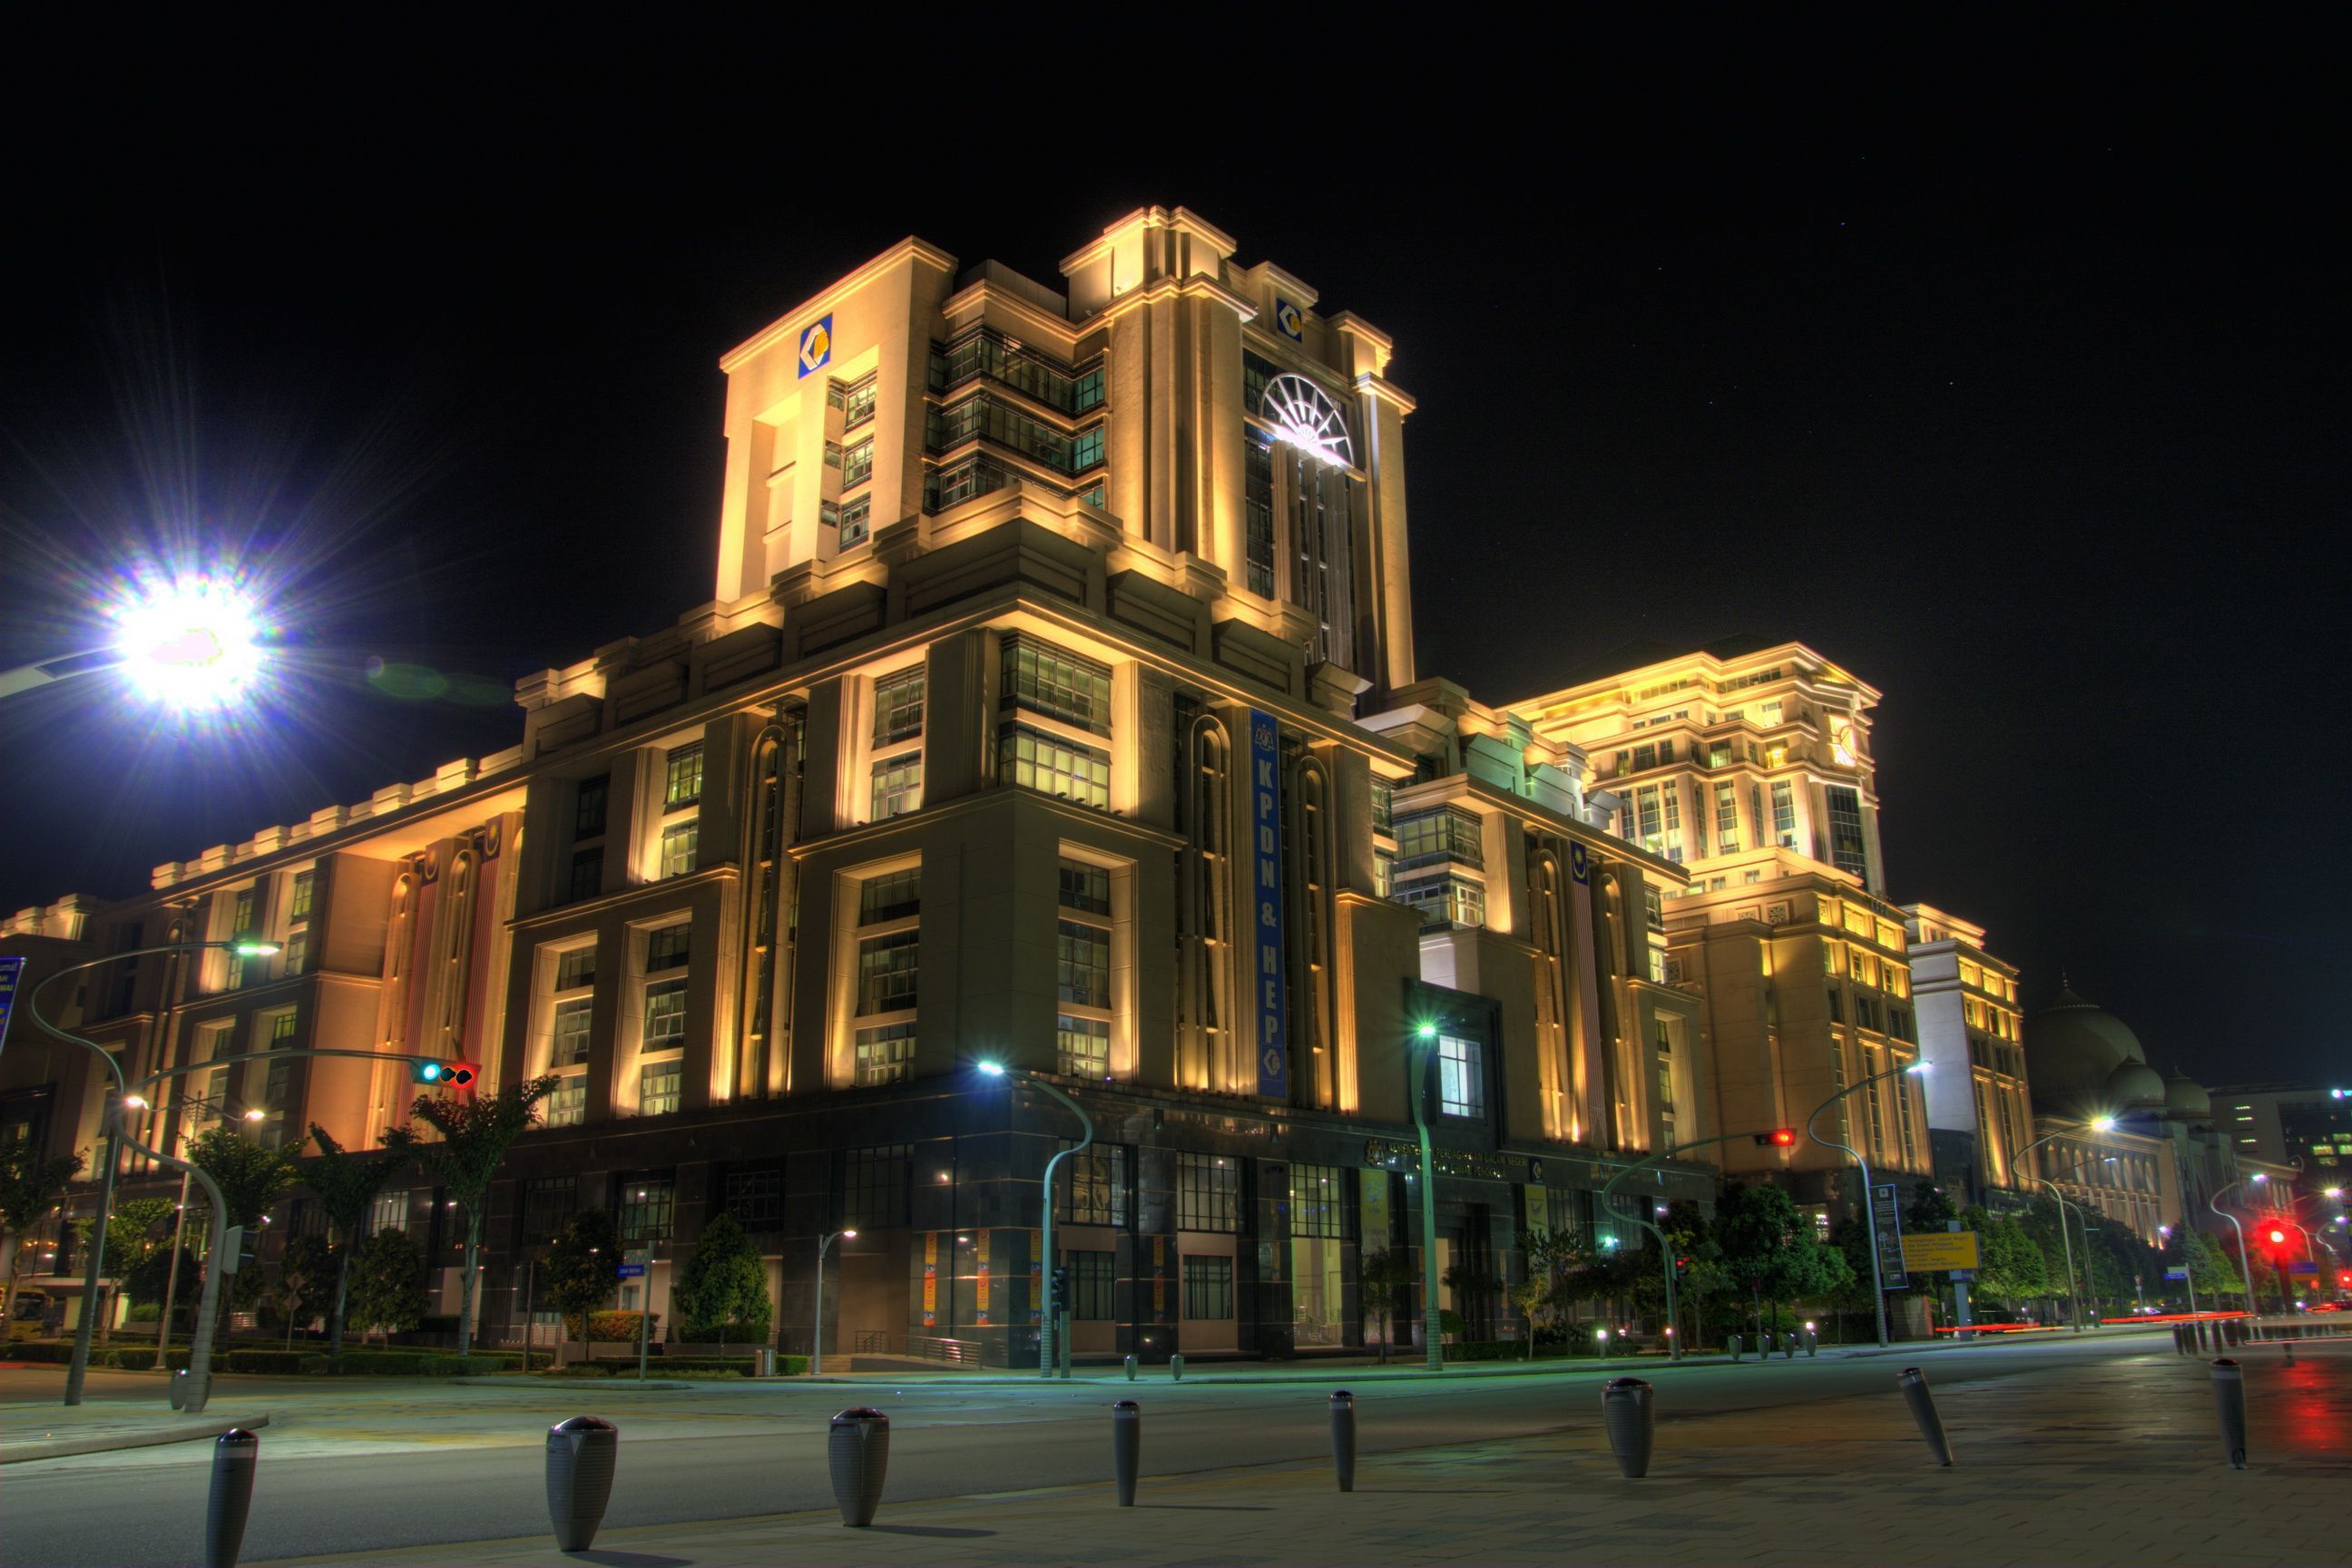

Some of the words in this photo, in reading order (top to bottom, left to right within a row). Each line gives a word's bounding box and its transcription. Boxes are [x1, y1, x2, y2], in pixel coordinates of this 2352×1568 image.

[1259, 759, 1276, 889] KPDN
[1261, 901, 1278, 928] &
[1262, 945, 1279, 1044] HEP
